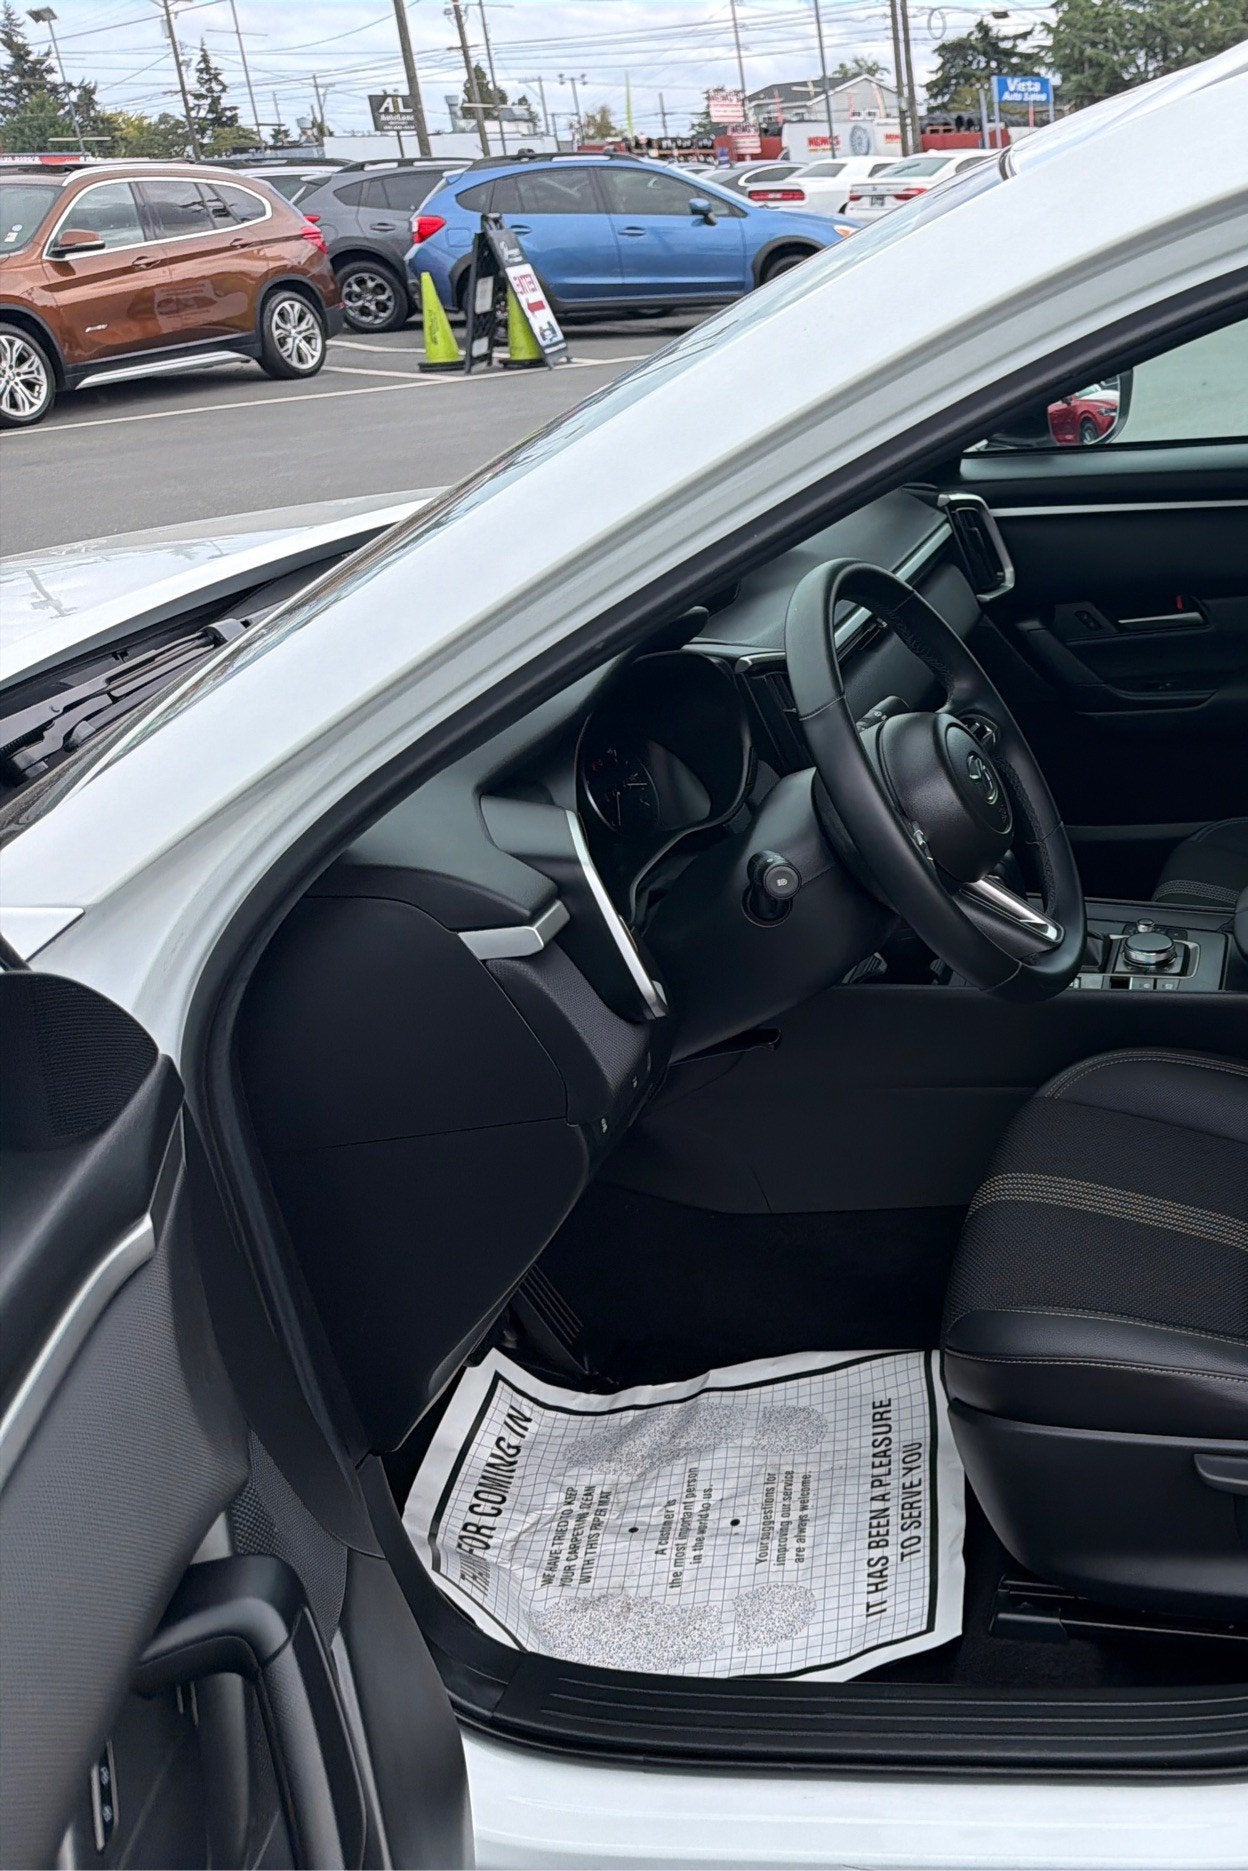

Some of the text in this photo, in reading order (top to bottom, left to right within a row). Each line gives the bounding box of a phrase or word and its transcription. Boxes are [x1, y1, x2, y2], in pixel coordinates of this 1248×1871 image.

[503, 1405, 533, 1439] IN
[468, 1436, 522, 1518] COMING
[664, 1498, 677, 1508] is
[699, 1502, 712, 1514] to
[703, 1484, 714, 1499] us.
[755, 1472, 776, 1566] Your suggestions for
[773, 1470, 794, 1566] improving our service
[794, 1470, 812, 1564] are always welcome.
[866, 1398, 893, 1618] IT HAS BEEN A PLEASURE
[901, 1441, 923, 1562] TO SERVE YOU
[457, 1522, 497, 1554] FOR
[541, 1486, 578, 1587] WE HAVE TRIED TO KEEP
[559, 1565, 576, 1587] YOUR
[580, 1485, 597, 1509] CLEAN
[579, 1490, 612, 1585] WITH THIS PAPER MAT
[658, 1508, 675, 1546] customer
[669, 1467, 699, 1589] the most important person
[690, 1554, 702, 1565] in
[692, 1536, 705, 1552] the
